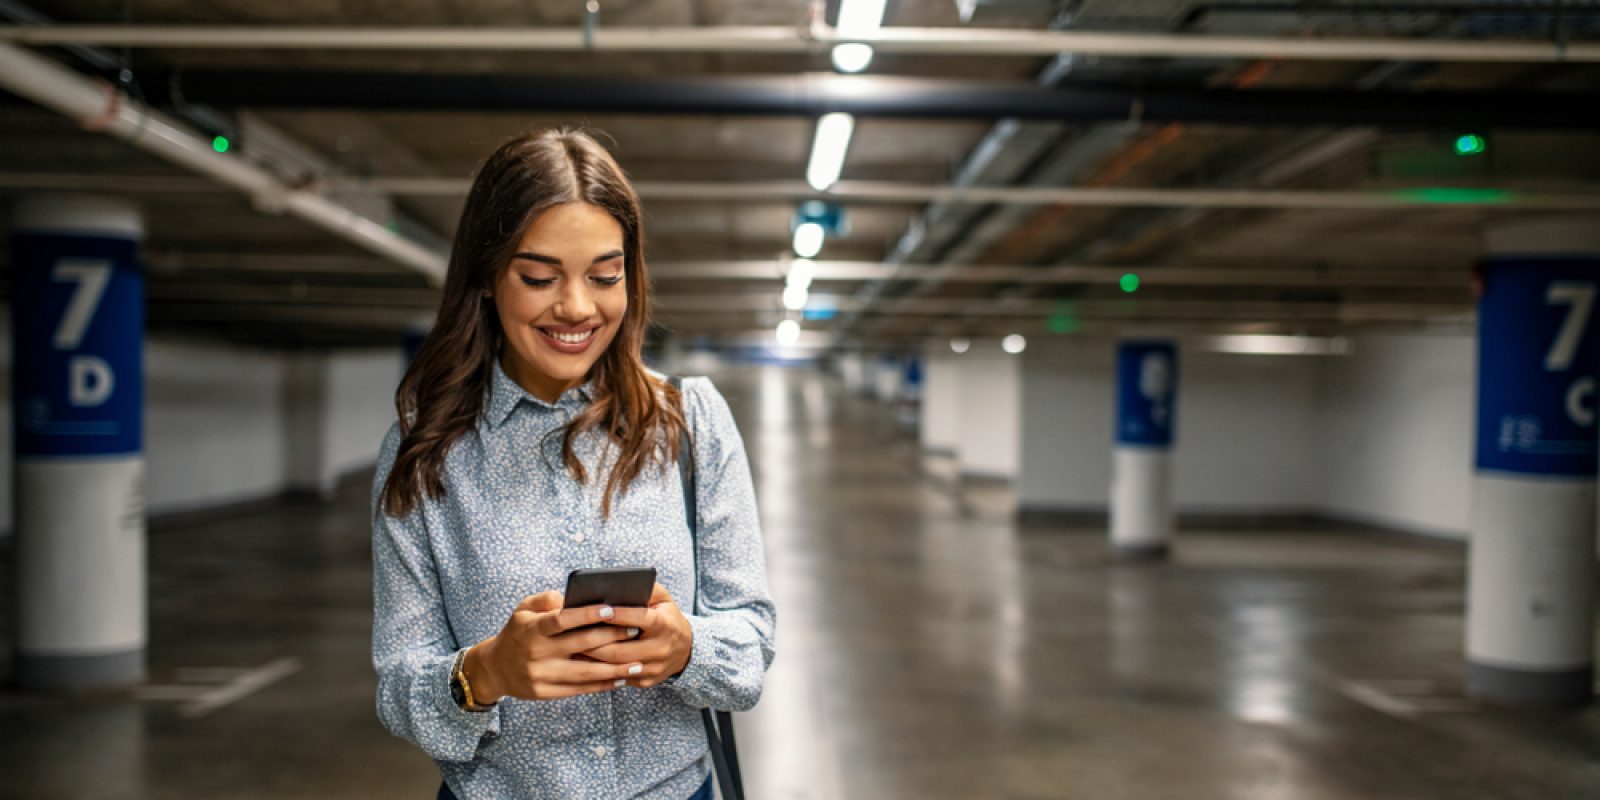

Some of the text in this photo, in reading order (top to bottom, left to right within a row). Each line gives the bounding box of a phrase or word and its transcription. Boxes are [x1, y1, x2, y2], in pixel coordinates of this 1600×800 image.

[52, 258, 111, 349] 7
[1545, 282, 1595, 370] 7
[69, 356, 115, 406] D
